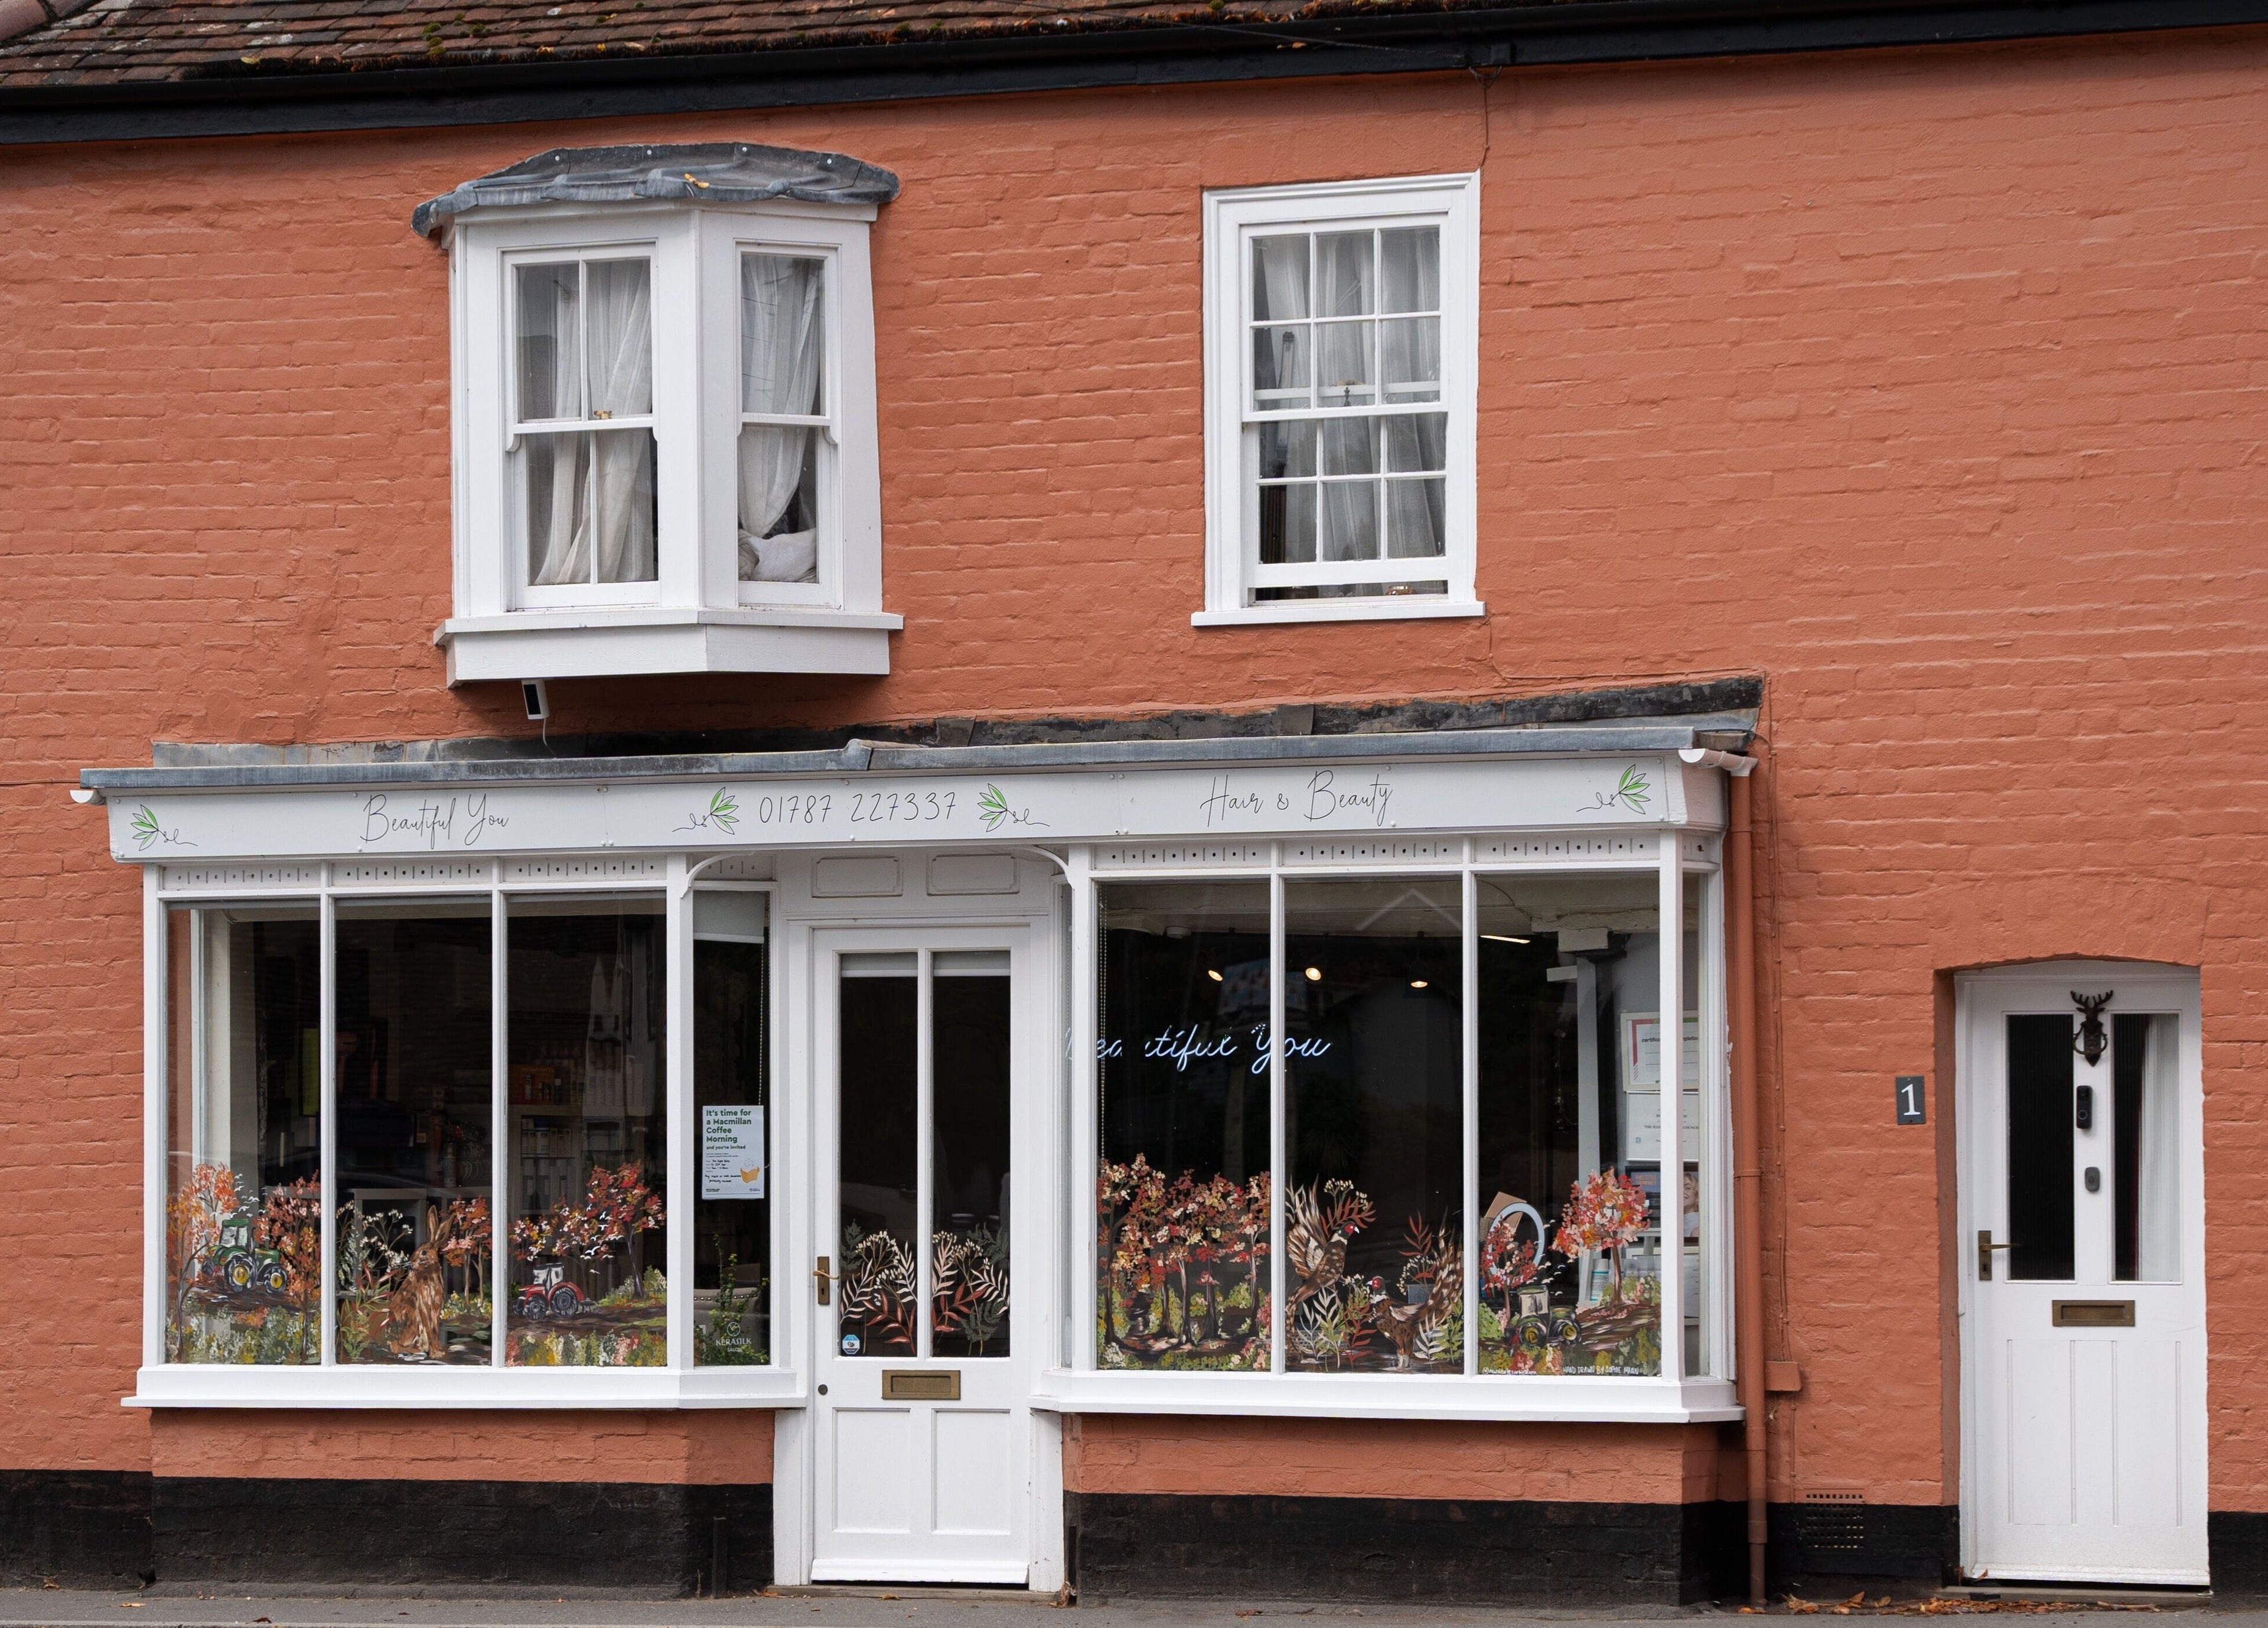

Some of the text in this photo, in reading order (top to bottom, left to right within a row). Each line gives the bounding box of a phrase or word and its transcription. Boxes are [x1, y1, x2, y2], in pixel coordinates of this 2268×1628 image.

[760, 792, 955, 823] 01787 227337
[1200, 770, 1393, 826] Hair & Beauty
[360, 793, 509, 849] Beautiful You
[1251, 1023, 1332, 1074] You
[1901, 1083, 1921, 1116] 1
[706, 1135, 738, 1144] Morning
[1596, 1365, 1604, 1375] BY
